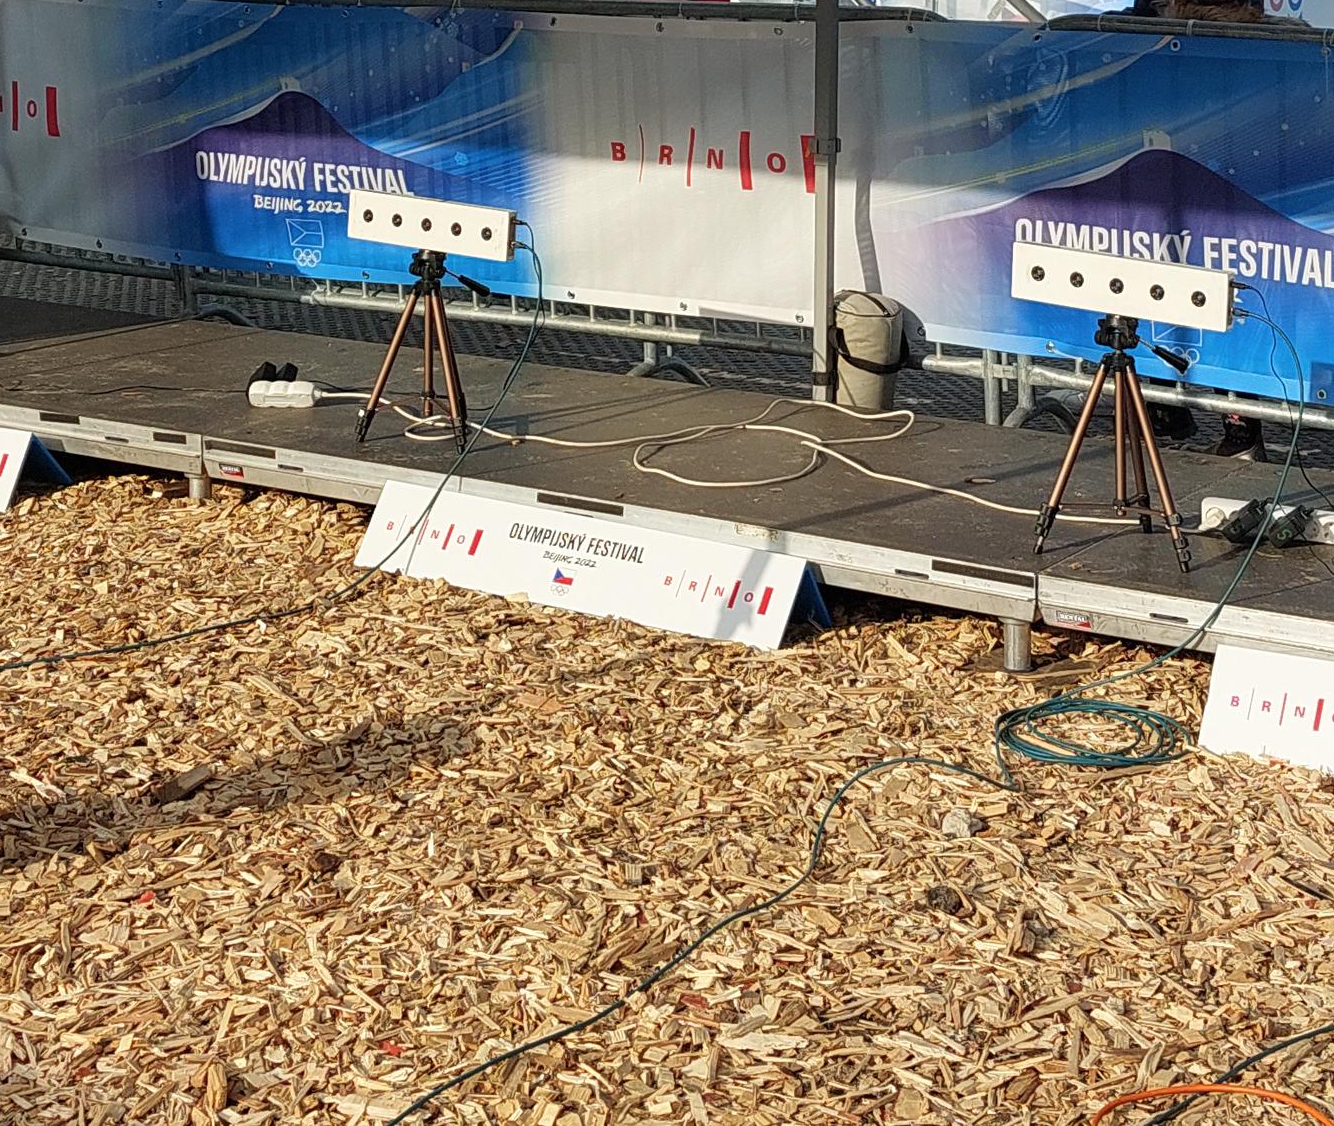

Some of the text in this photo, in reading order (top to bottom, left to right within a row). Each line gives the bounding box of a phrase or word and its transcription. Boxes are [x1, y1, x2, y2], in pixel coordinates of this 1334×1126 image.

[195, 149, 415, 197] OLYMPIJSKÝ FESTIVAL
[253, 194, 347, 215] BEIJING 2022
[509, 522, 646, 565] OLYMPIJSKÝ FESTIVAL
[543, 550, 597, 568] BEIJING 2022
